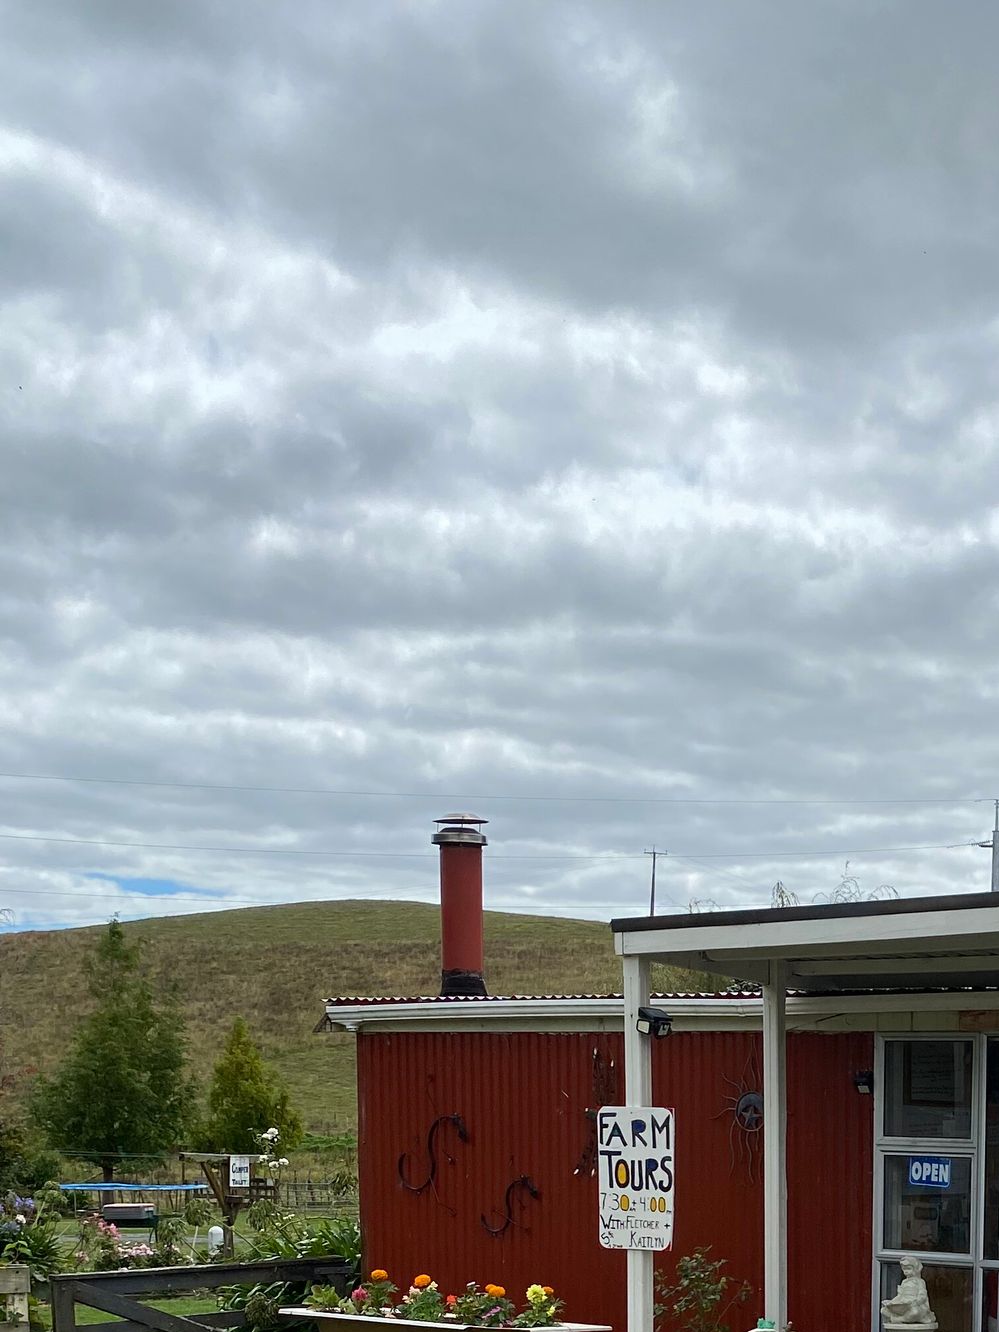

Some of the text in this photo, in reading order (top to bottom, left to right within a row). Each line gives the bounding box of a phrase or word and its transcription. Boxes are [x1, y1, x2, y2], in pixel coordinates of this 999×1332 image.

[600, 1112, 671, 1149] FARM
[600, 1150, 673, 1193] TOURS
[911, 1161, 949, 1183] OPEN
[600, 1214, 625, 1230] WITH
[626, 1215, 660, 1230] FLETCHER
[628, 1230, 665, 1248] KAITLYN
